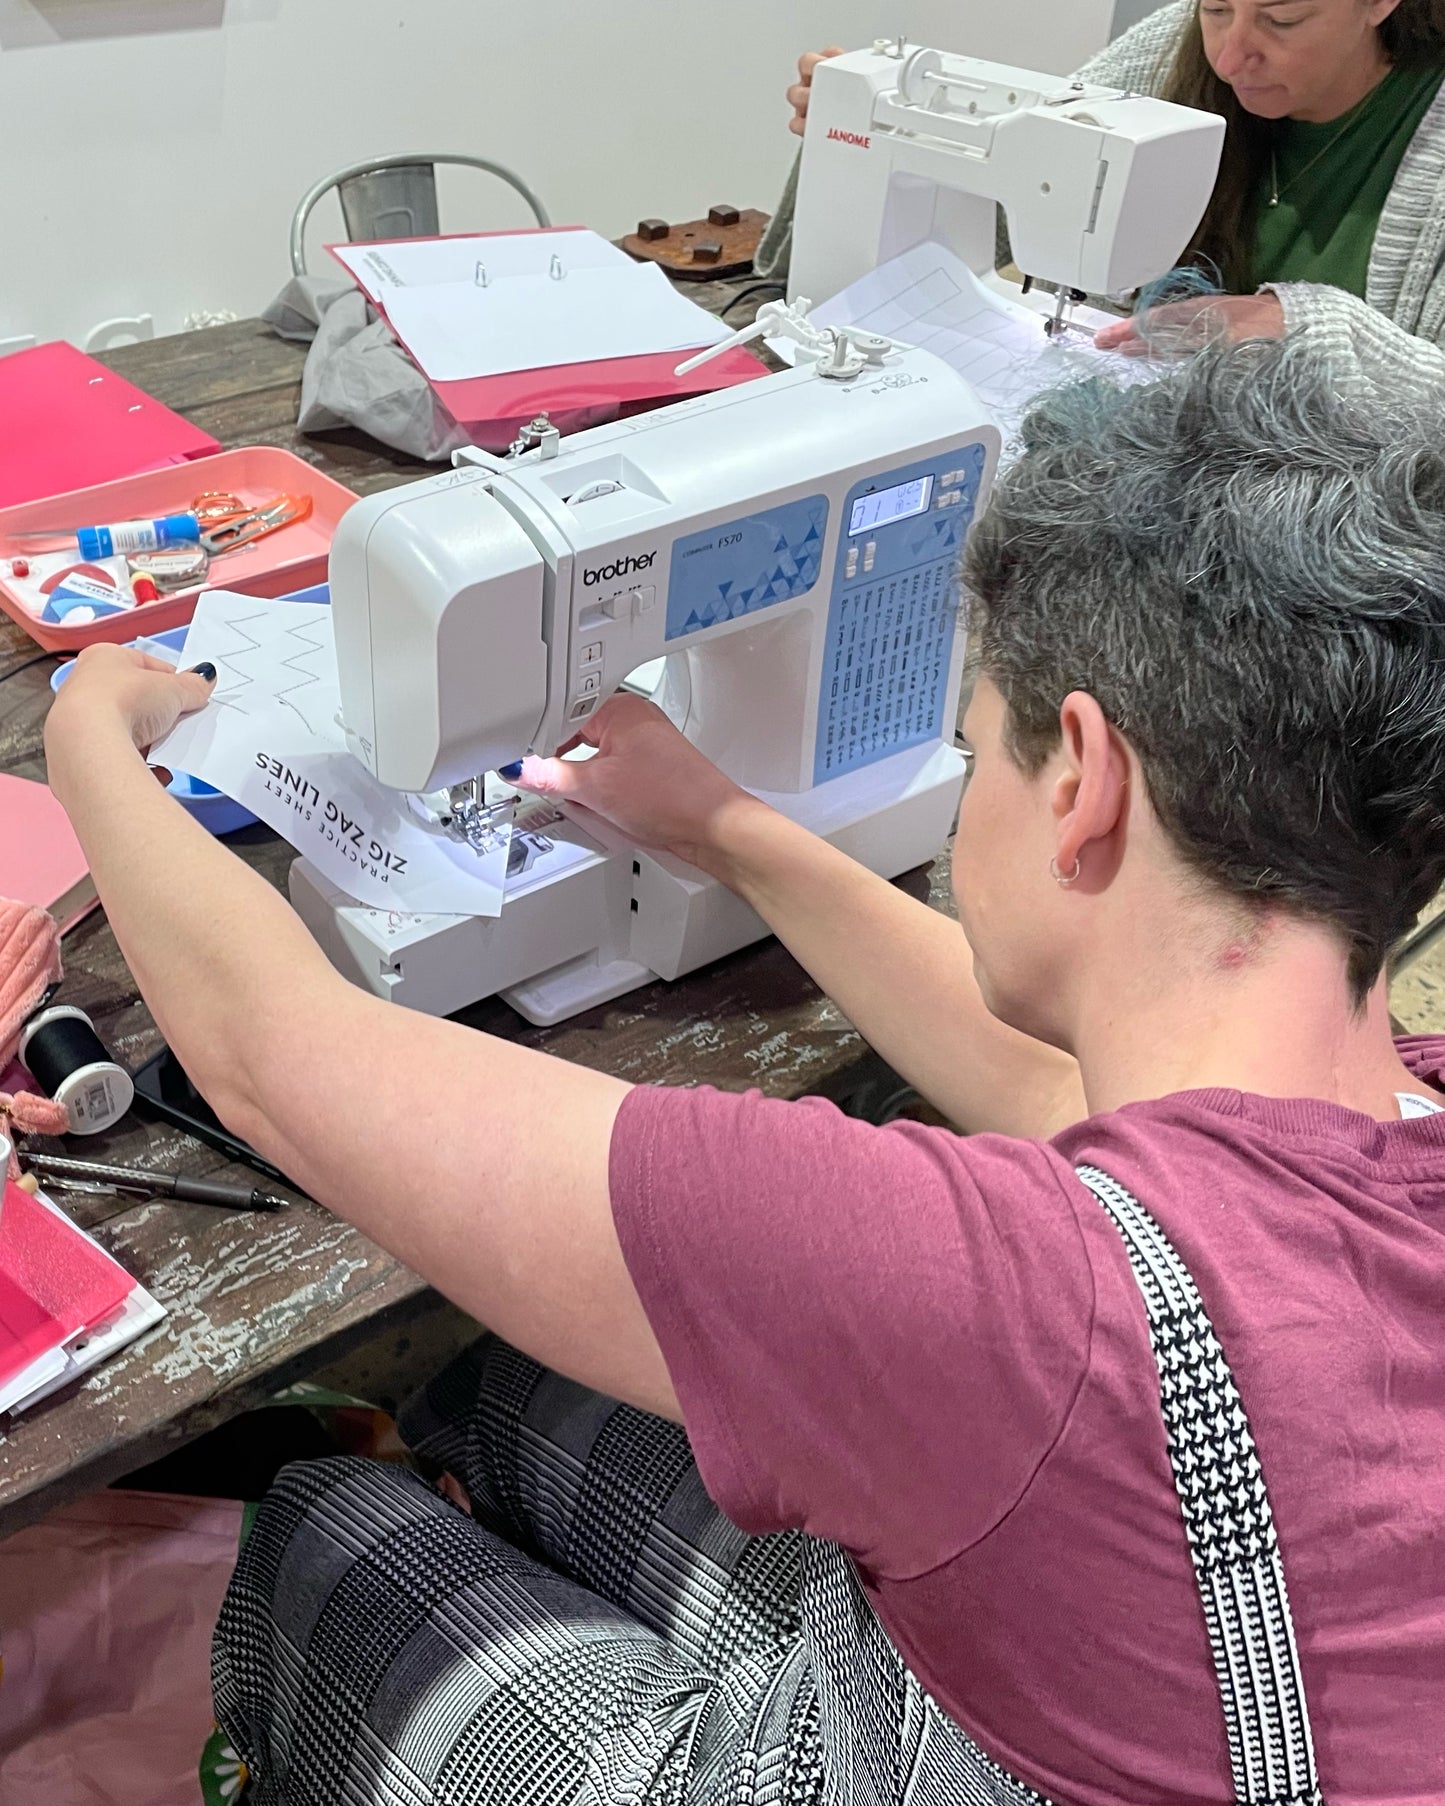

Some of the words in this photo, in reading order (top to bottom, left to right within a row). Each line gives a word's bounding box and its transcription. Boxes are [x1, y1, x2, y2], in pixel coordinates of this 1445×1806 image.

[826, 127, 871, 149] JANOME
[718, 532, 743, 549] FS70
[583, 550, 657, 586] brother
[255, 752, 320, 806] LINES
[264, 780, 312, 821] SHEET
[324, 800, 365, 848] ZAG
[318, 822, 389, 883] PRACTICE
[368, 840, 408, 874] ZIG
